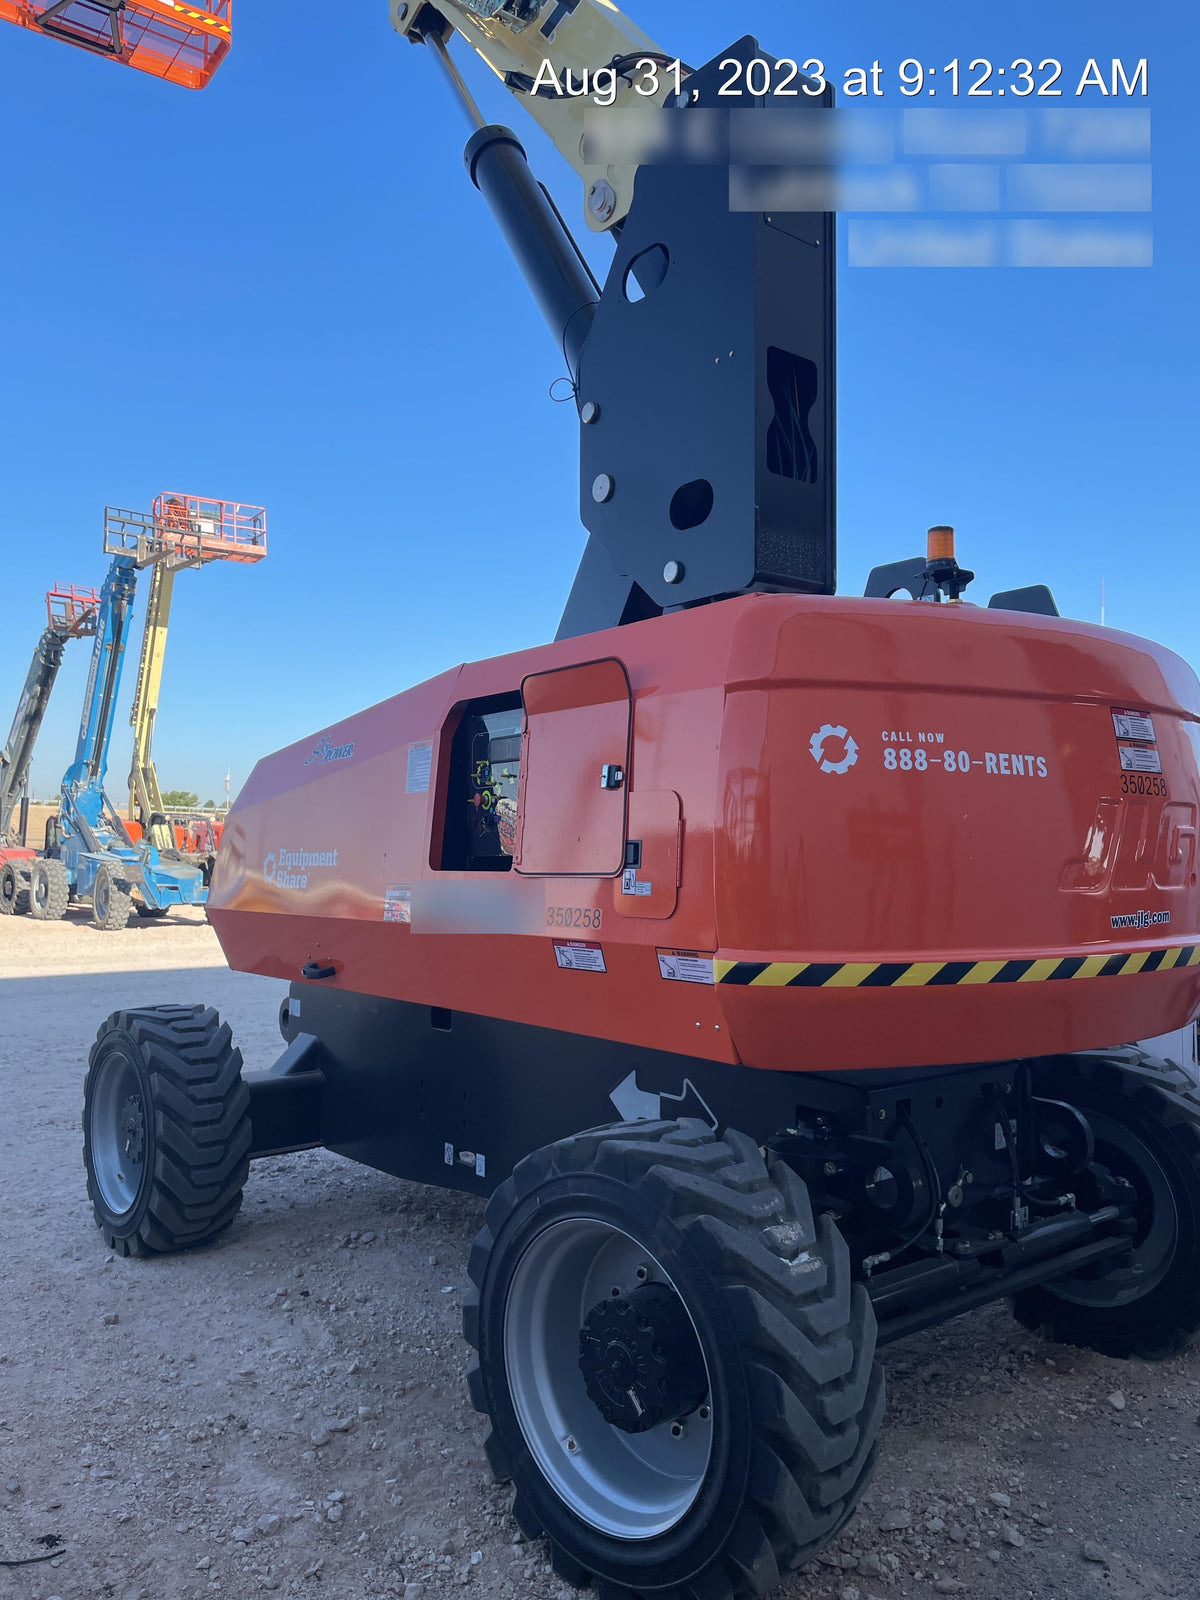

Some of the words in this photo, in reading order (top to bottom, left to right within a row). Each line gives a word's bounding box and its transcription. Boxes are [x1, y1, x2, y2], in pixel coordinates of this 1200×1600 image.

[881, 731, 913, 742] CALL
[918, 732, 945, 744] NOW
[883, 747, 1048, 778] 888-80-RENTS
[1120, 774, 1168, 797] 350258
[279, 848, 339, 871] Equipment
[276, 870, 308, 889] Share
[547, 907, 601, 929] 350258
[1110, 909, 1171, 929] www.jlg.com
